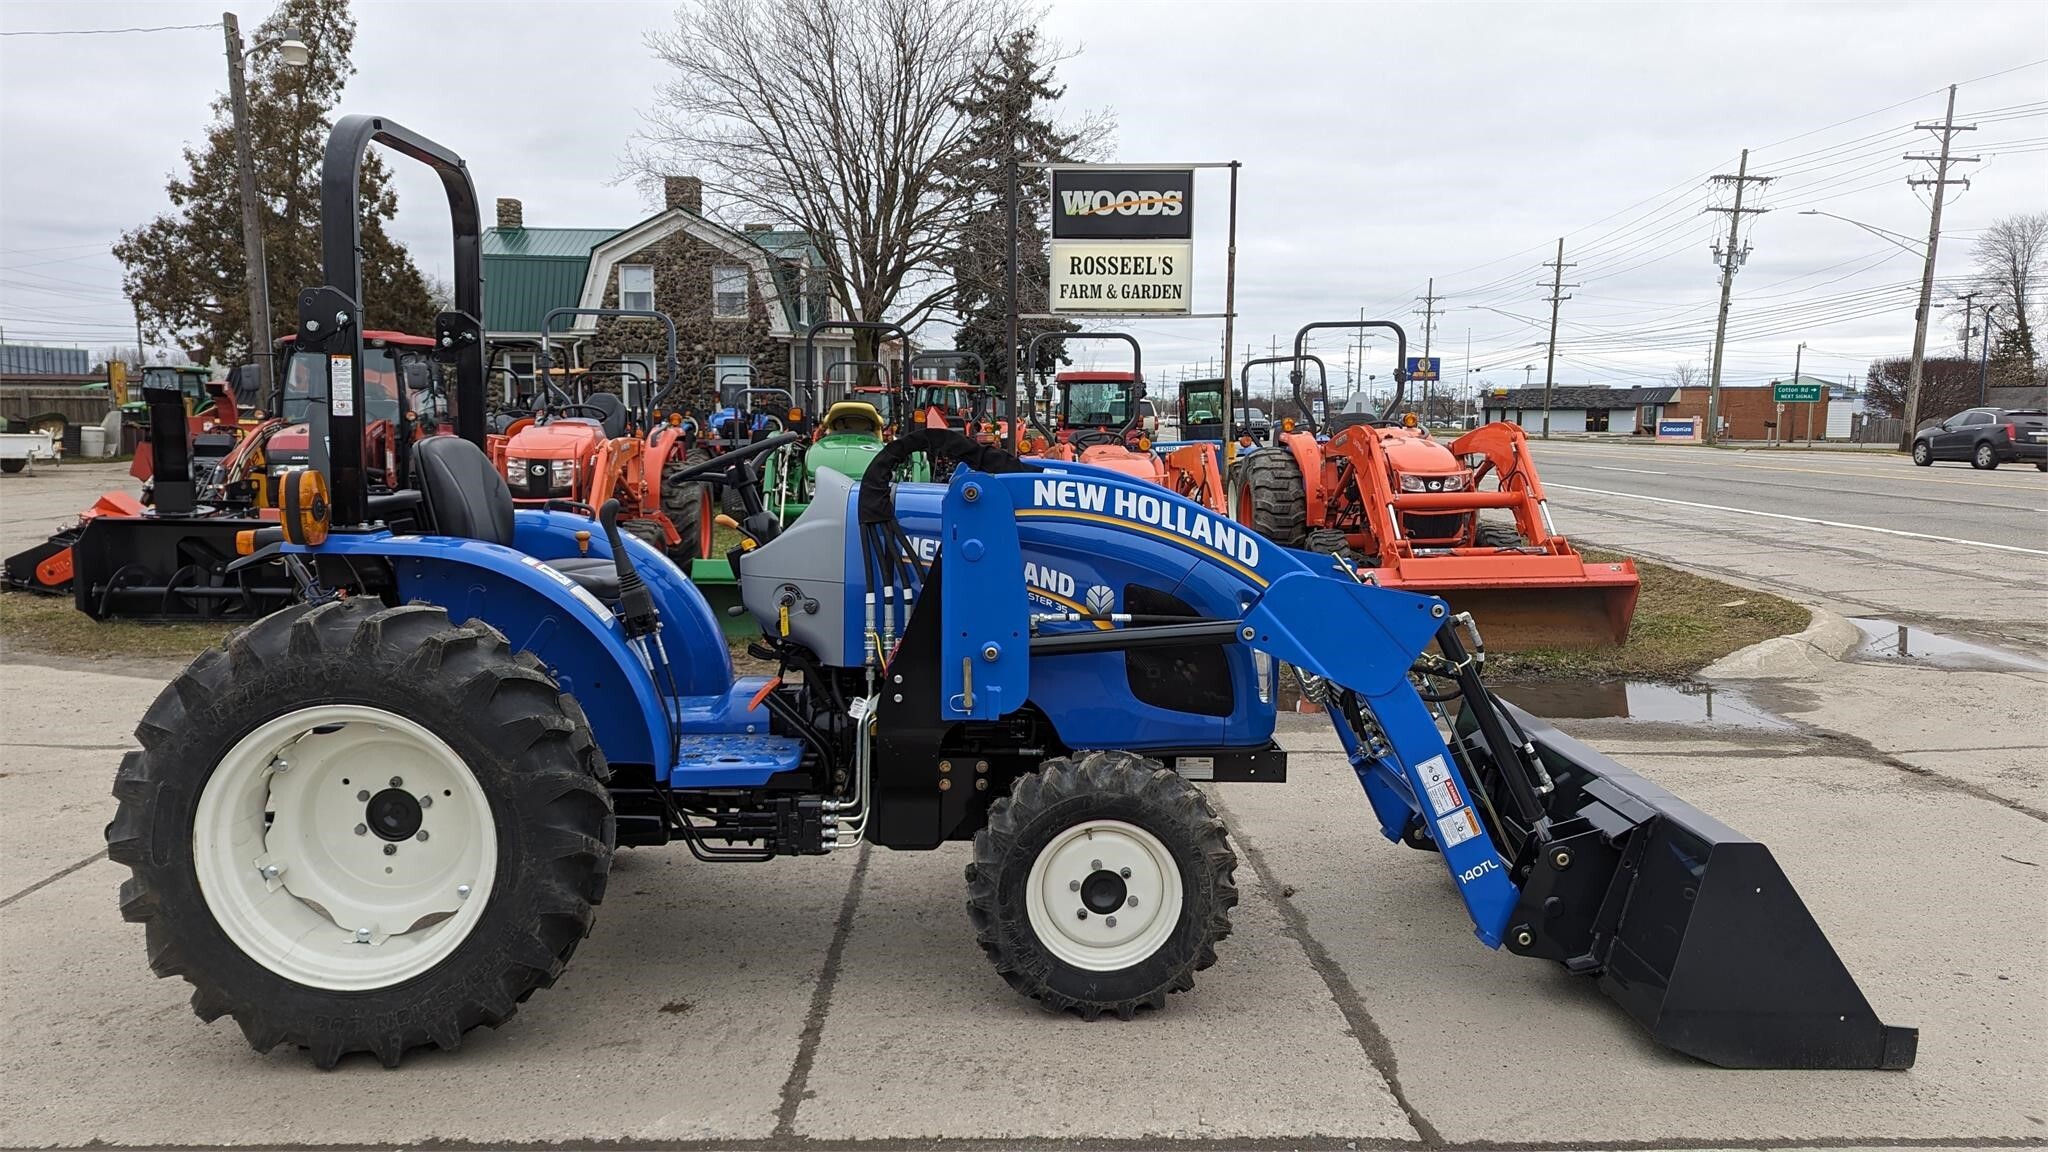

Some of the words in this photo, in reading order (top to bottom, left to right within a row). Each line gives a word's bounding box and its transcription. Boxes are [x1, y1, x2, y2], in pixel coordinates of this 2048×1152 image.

[1061, 190, 1183, 216] WOODS
[1070, 256, 1173, 276] ROSSEEL'S
[1060, 284, 1102, 299] FARM
[1106, 284, 1118, 299] &
[1121, 284, 1182, 300] GARDEN
[1034, 480, 1107, 511] NEW
[1114, 489, 1259, 568] HOLLAND
[901, 535, 942, 561] NE
[1024, 562, 1075, 598] AND
[1028, 593, 1053, 608] STER
